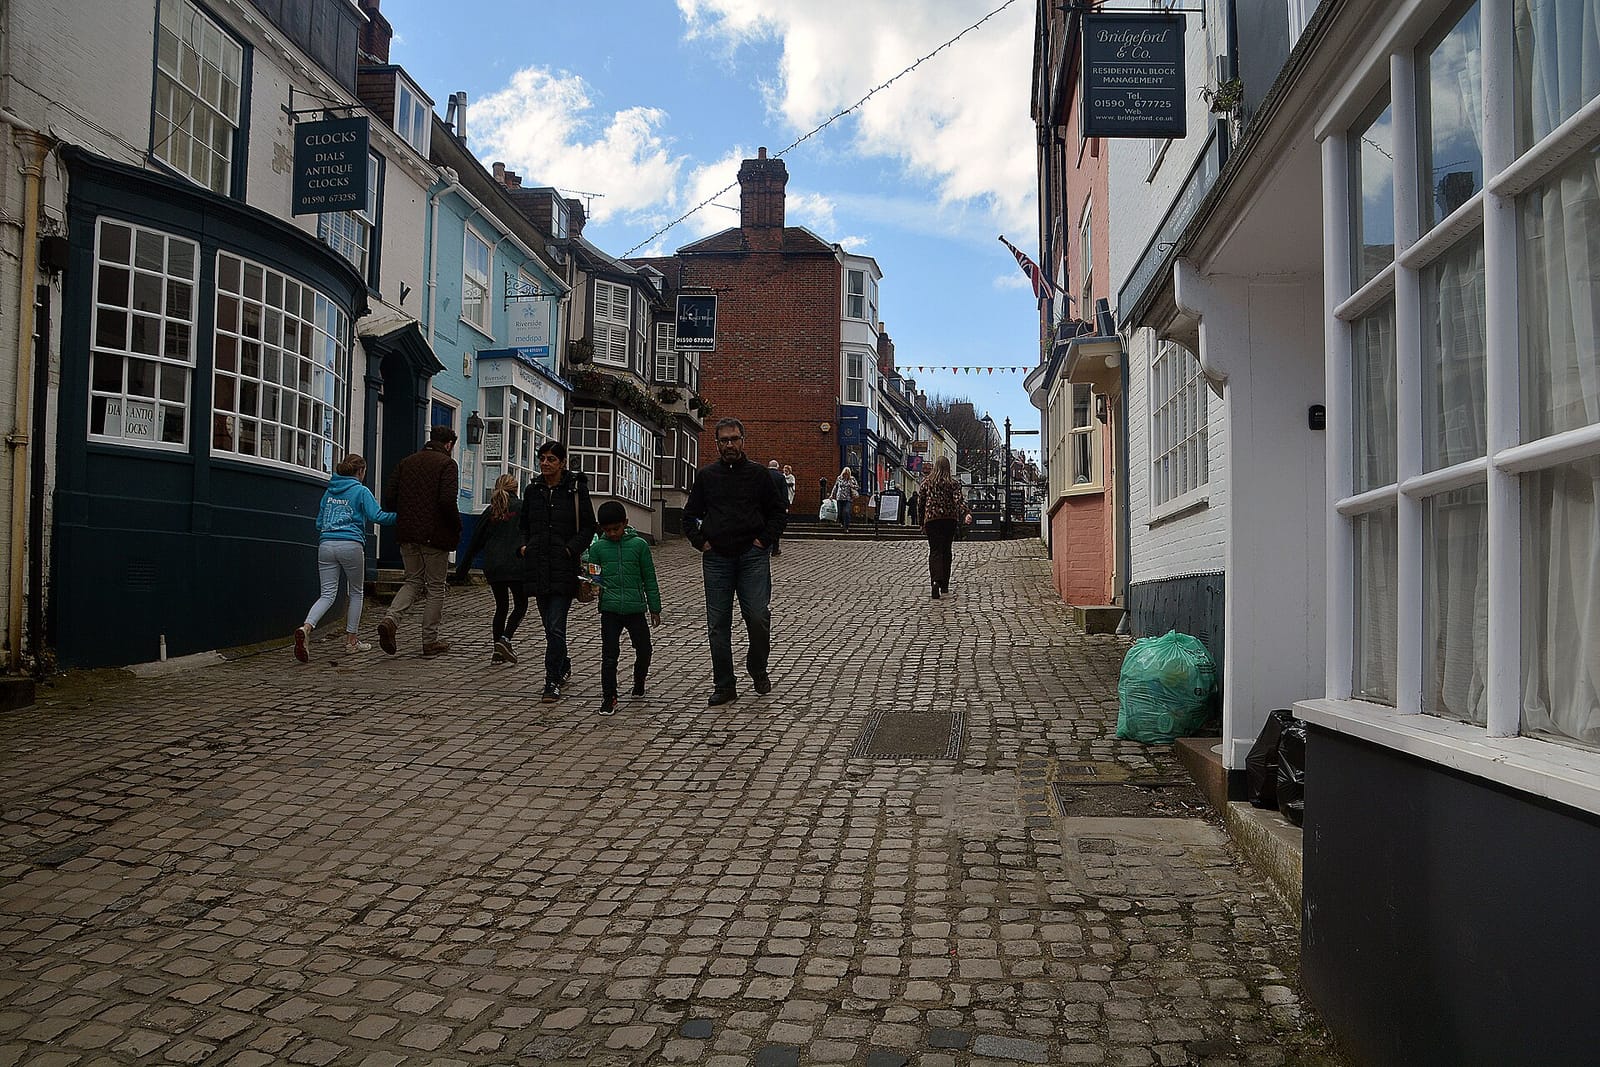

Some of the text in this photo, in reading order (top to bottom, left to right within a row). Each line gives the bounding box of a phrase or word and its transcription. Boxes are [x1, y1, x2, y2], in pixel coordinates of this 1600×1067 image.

[1096, 29, 1170, 47] Bridgeford
[1116, 46, 1151, 59] & Co.
[1092, 67, 1147, 75] RESIDENTIAL
[1126, 92, 1142, 100] Tel.
[1094, 100, 1125, 108] 01590
[305, 131, 357, 146] CLOCKS
[315, 152, 345, 161] DIALS
[305, 164, 353, 176] ANTIQUE
[308, 177, 350, 189] CLOCKS
[302, 196, 325, 204] 01590
[129, 408, 163, 422] ANTIQE
[327, 496, 350, 506] Penny
